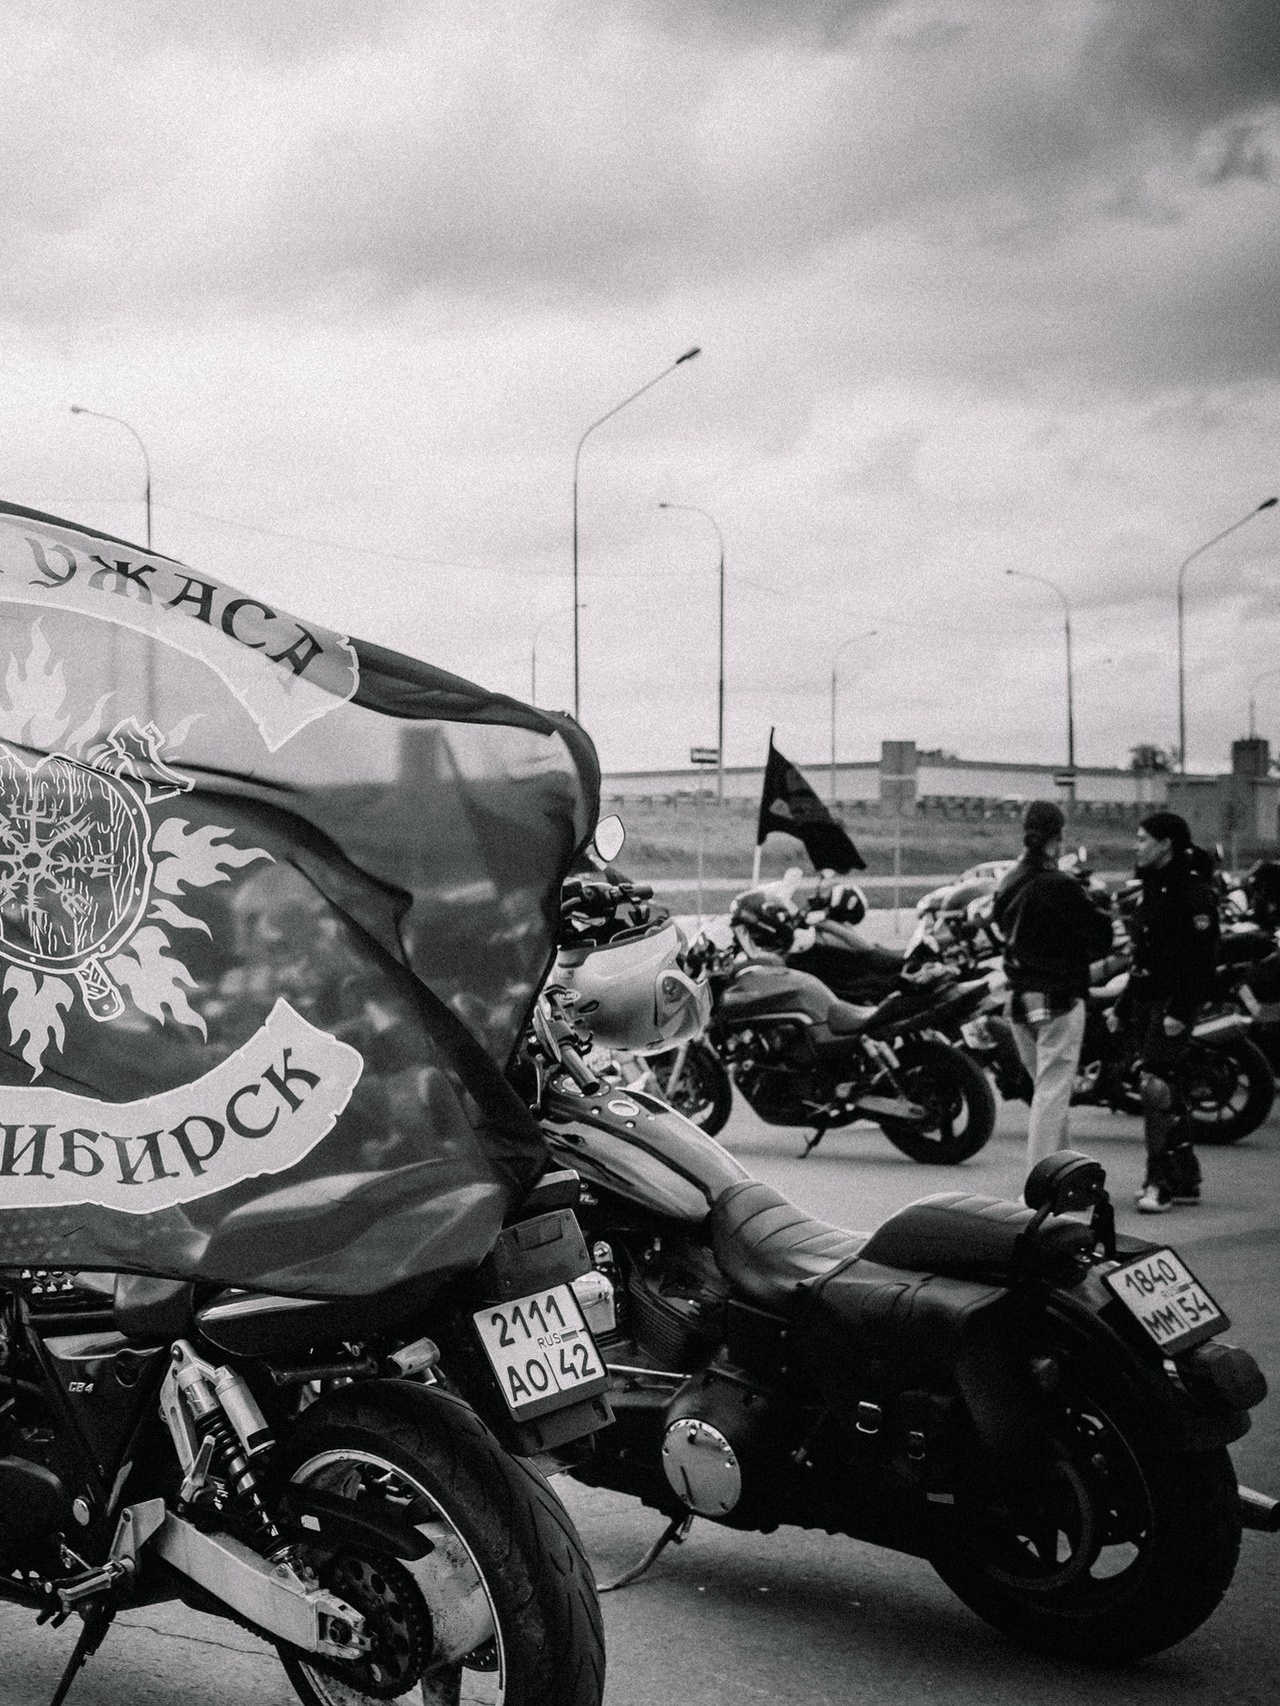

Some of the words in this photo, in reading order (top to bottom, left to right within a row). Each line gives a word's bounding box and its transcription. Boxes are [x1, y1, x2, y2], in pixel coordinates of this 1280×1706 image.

[24, 536, 325, 693] УЖАСА
[1124, 1258, 1177, 1297] 1840
[490, 1294, 566, 1348] 2111
[1176, 1292, 1214, 1322] 54
[536, 1332, 561, 1350] RUS
[560, 1343, 597, 1380] 42
